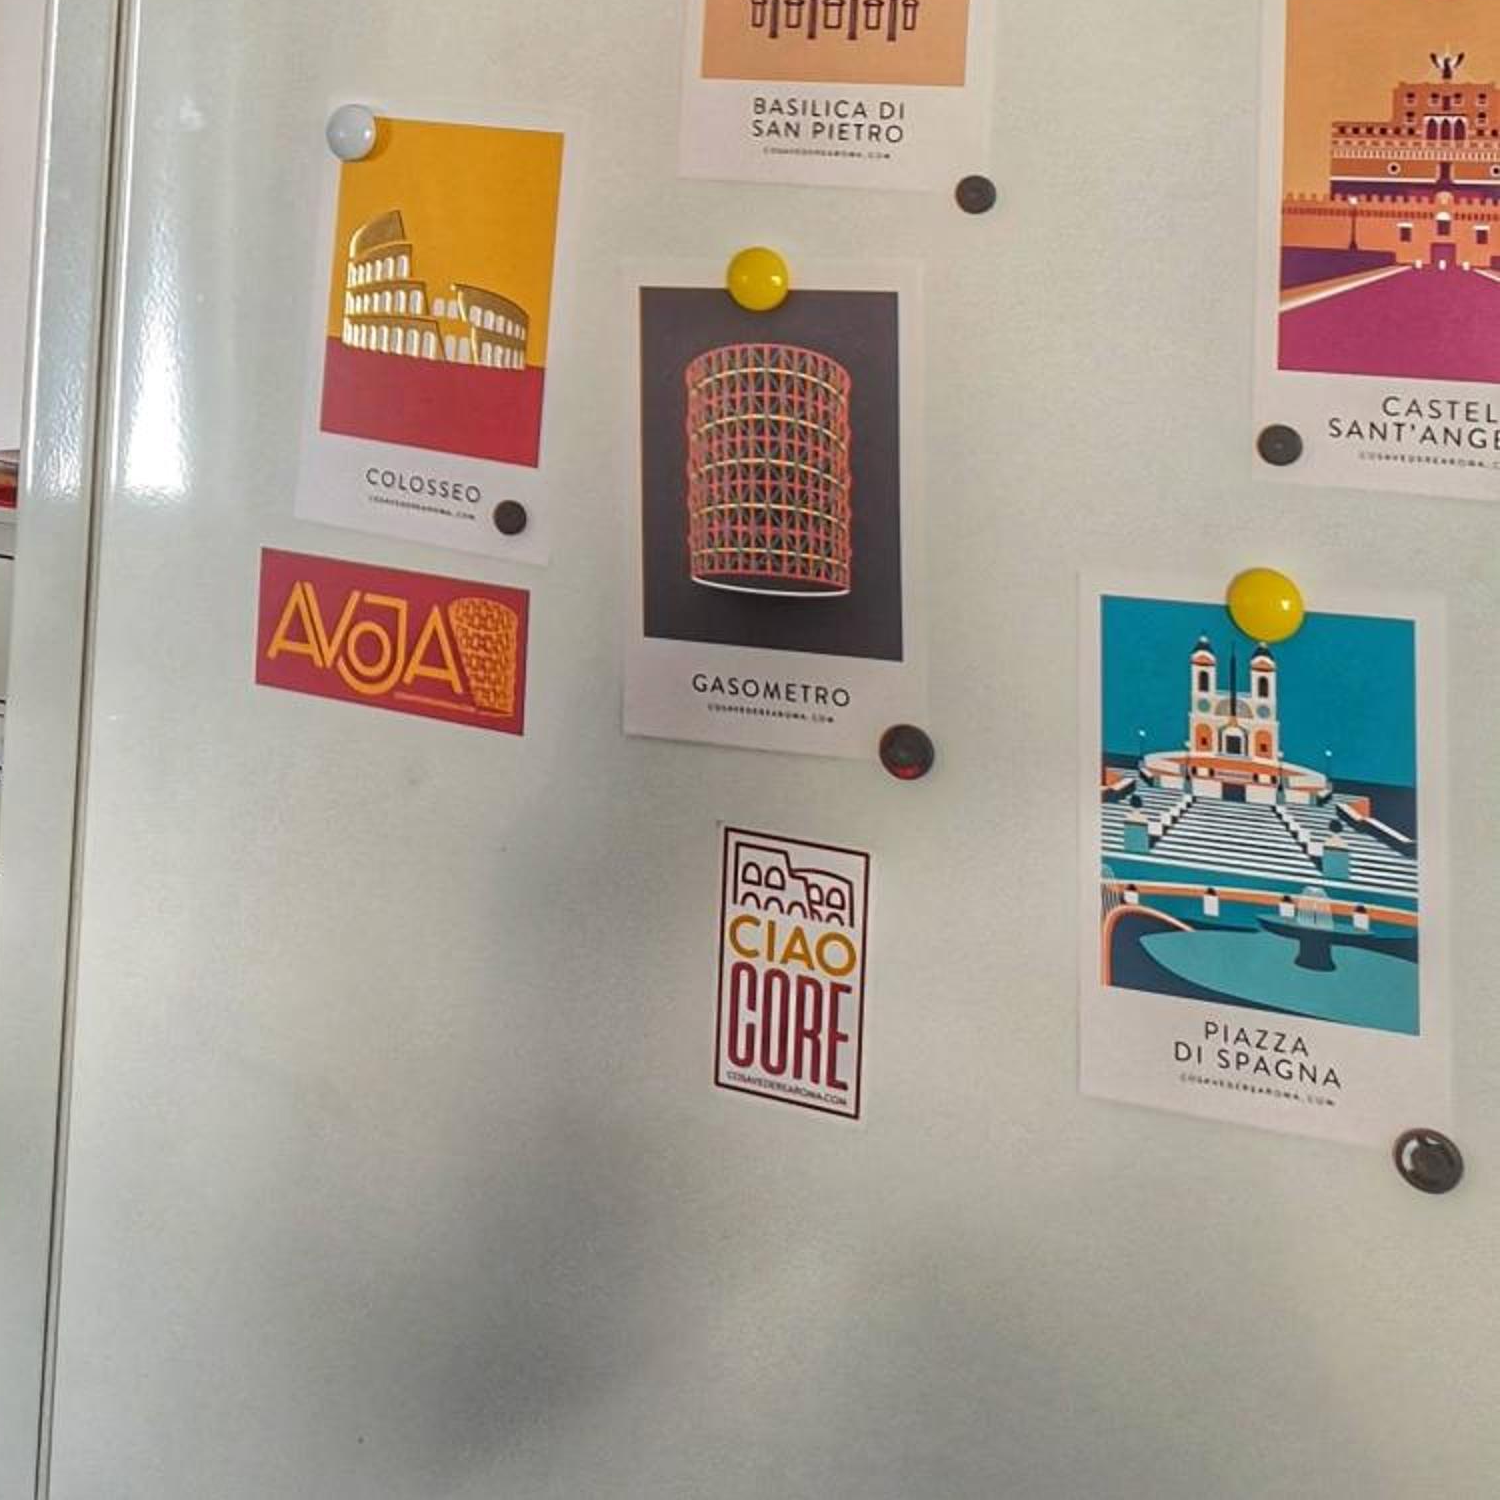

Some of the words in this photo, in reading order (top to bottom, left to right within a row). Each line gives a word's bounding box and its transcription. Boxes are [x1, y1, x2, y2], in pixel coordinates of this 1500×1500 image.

[753, 97, 868, 119] BASILICA
[879, 101, 905, 120] DI
[752, 119, 801, 139] SAN
[812, 121, 904, 143] PIETRO
[1382, 395, 1498, 424] CASTEL
[365, 467, 481, 503] COLOSSEO
[267, 580, 463, 695] AVOJA
[692, 673, 850, 707] GASOMETRO
[728, 914, 857, 977] CIAO
[727, 961, 853, 1091] CORE
[1204, 1021, 1309, 1057] PIAZZA
[1173, 1041, 1202, 1064] DI
[1217, 1049, 1341, 1088] SPAGNA
